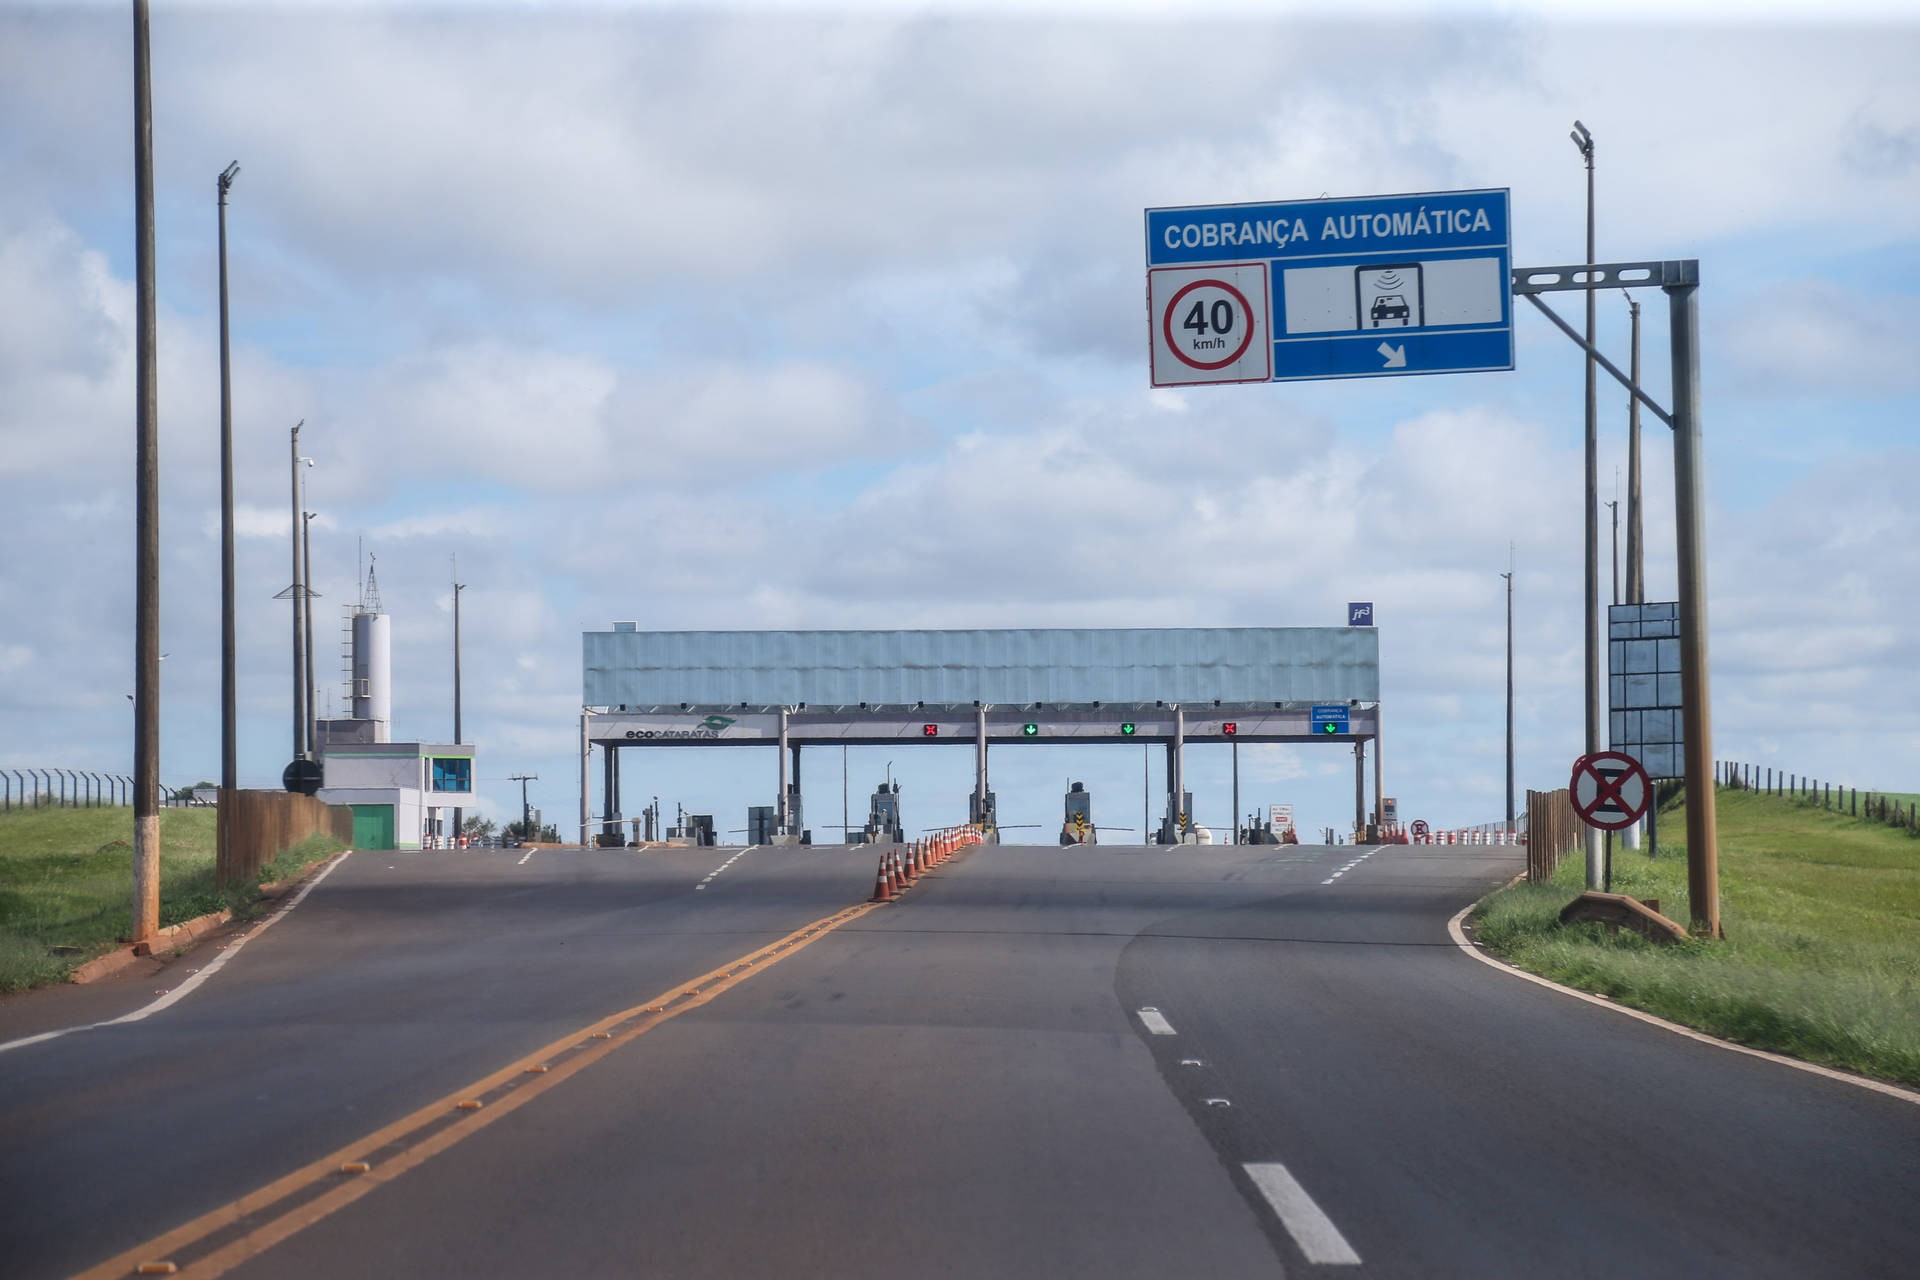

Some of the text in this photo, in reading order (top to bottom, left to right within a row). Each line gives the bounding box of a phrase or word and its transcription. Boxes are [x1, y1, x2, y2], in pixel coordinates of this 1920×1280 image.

[1164, 206, 1491, 249] COBRANÇA AUTOMÁTICA
[1183, 300, 1235, 336] 40
[1193, 337, 1226, 350] km/h
